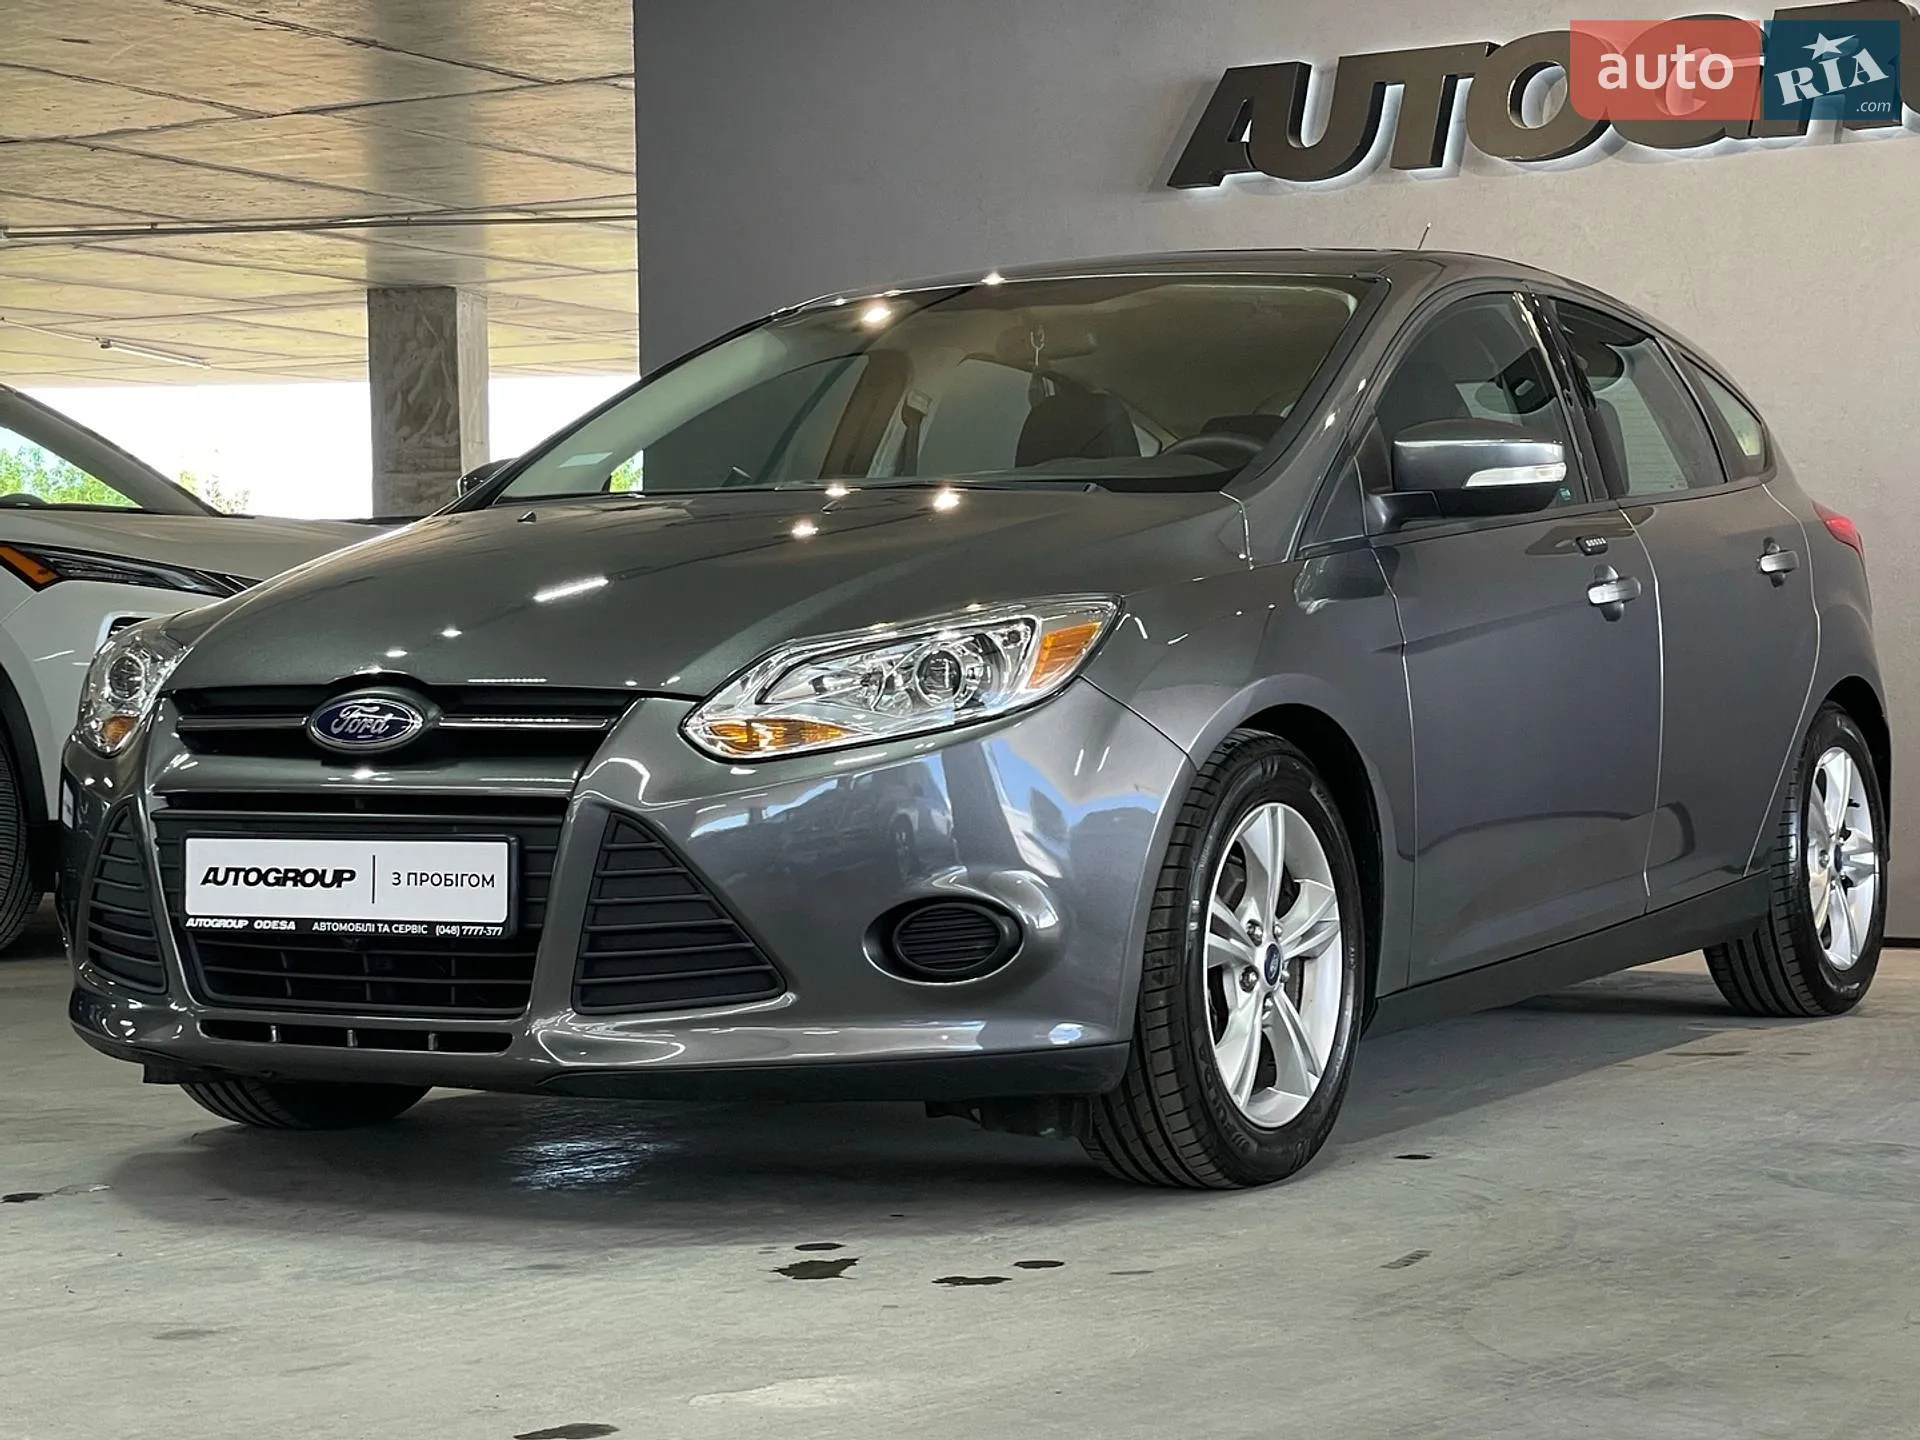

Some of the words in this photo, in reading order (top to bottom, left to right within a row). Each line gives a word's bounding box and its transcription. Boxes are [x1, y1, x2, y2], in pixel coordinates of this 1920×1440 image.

[330, 705, 396, 736] Ford
[200, 866, 356, 889] AUTOGROUP
[406, 872, 496, 889] ПРОБІГОМ
[185, 917, 249, 929] AUTOGROUP
[253, 919, 297, 931] ODESA
[312, 921, 375, 933] АВТОМОБІЛІ
[376, 923, 391, 934] ТА
[391, 924, 429, 935] СЕРВІС
[435, 924, 461, 938] (048)
